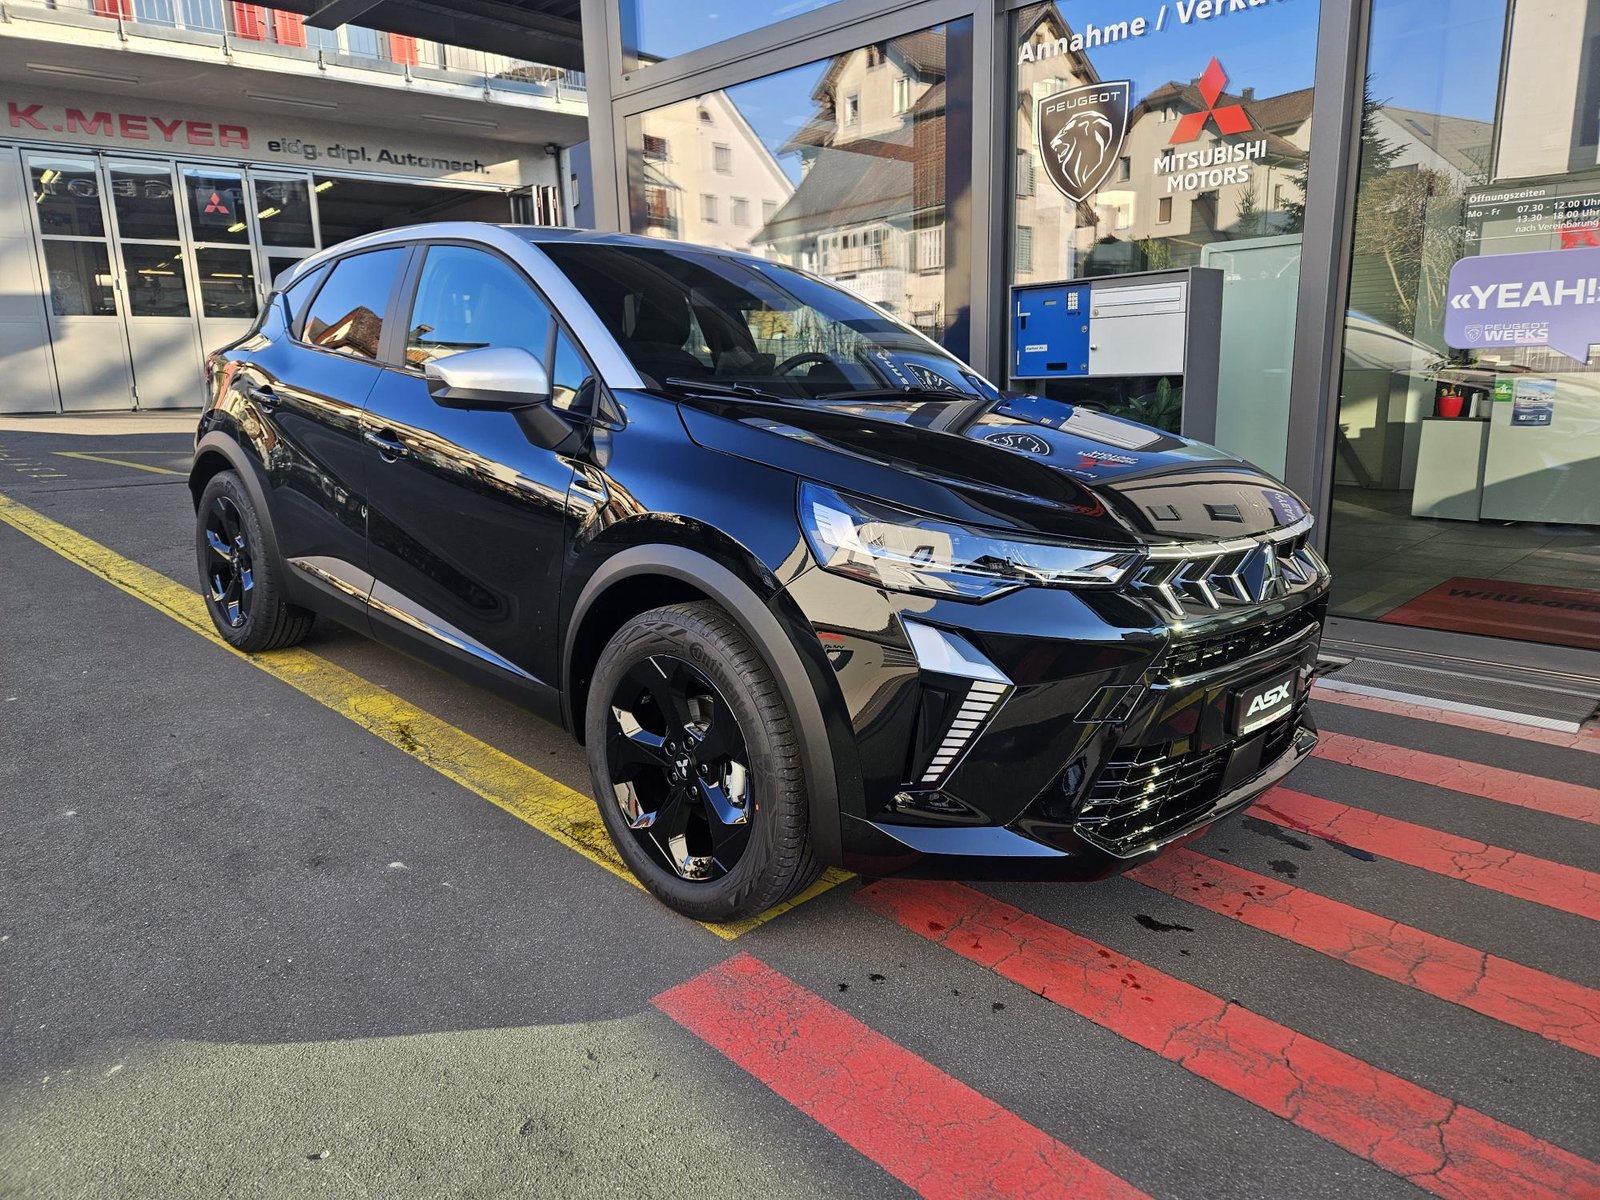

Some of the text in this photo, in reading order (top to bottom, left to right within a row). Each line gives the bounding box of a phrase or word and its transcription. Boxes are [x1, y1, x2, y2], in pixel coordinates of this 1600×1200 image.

[1018, 16, 1146, 65] Annahme
[1155, 5, 1166, 31] /
[1046, 91, 1121, 116] PEUGEOT
[7, 102, 249, 149] K.MEYER
[268, 138, 491, 175] eidg. dipl. Automech.
[1154, 139, 1267, 175] MITSUBISHI
[1167, 164, 1249, 193] MOTORS
[1467, 210, 1483, 218] Mo
[1491, 208, 1501, 216] Fr
[1517, 203, 1544, 213] 07.30
[1553, 200, 1580, 210] 12.00
[1468, 189, 1546, 204] Öffnungszeiten
[1515, 225, 1536, 233] nach
[1538, 219, 1599, 231] Vereinbarung
[1516, 213, 1543, 223] 13.30
[1553, 210, 1579, 220] 18.00
[1484, 322, 1549, 331] PEUGEOT
[1484, 329, 1549, 342] WEEKS
[1246, 680, 1291, 717] ASX
